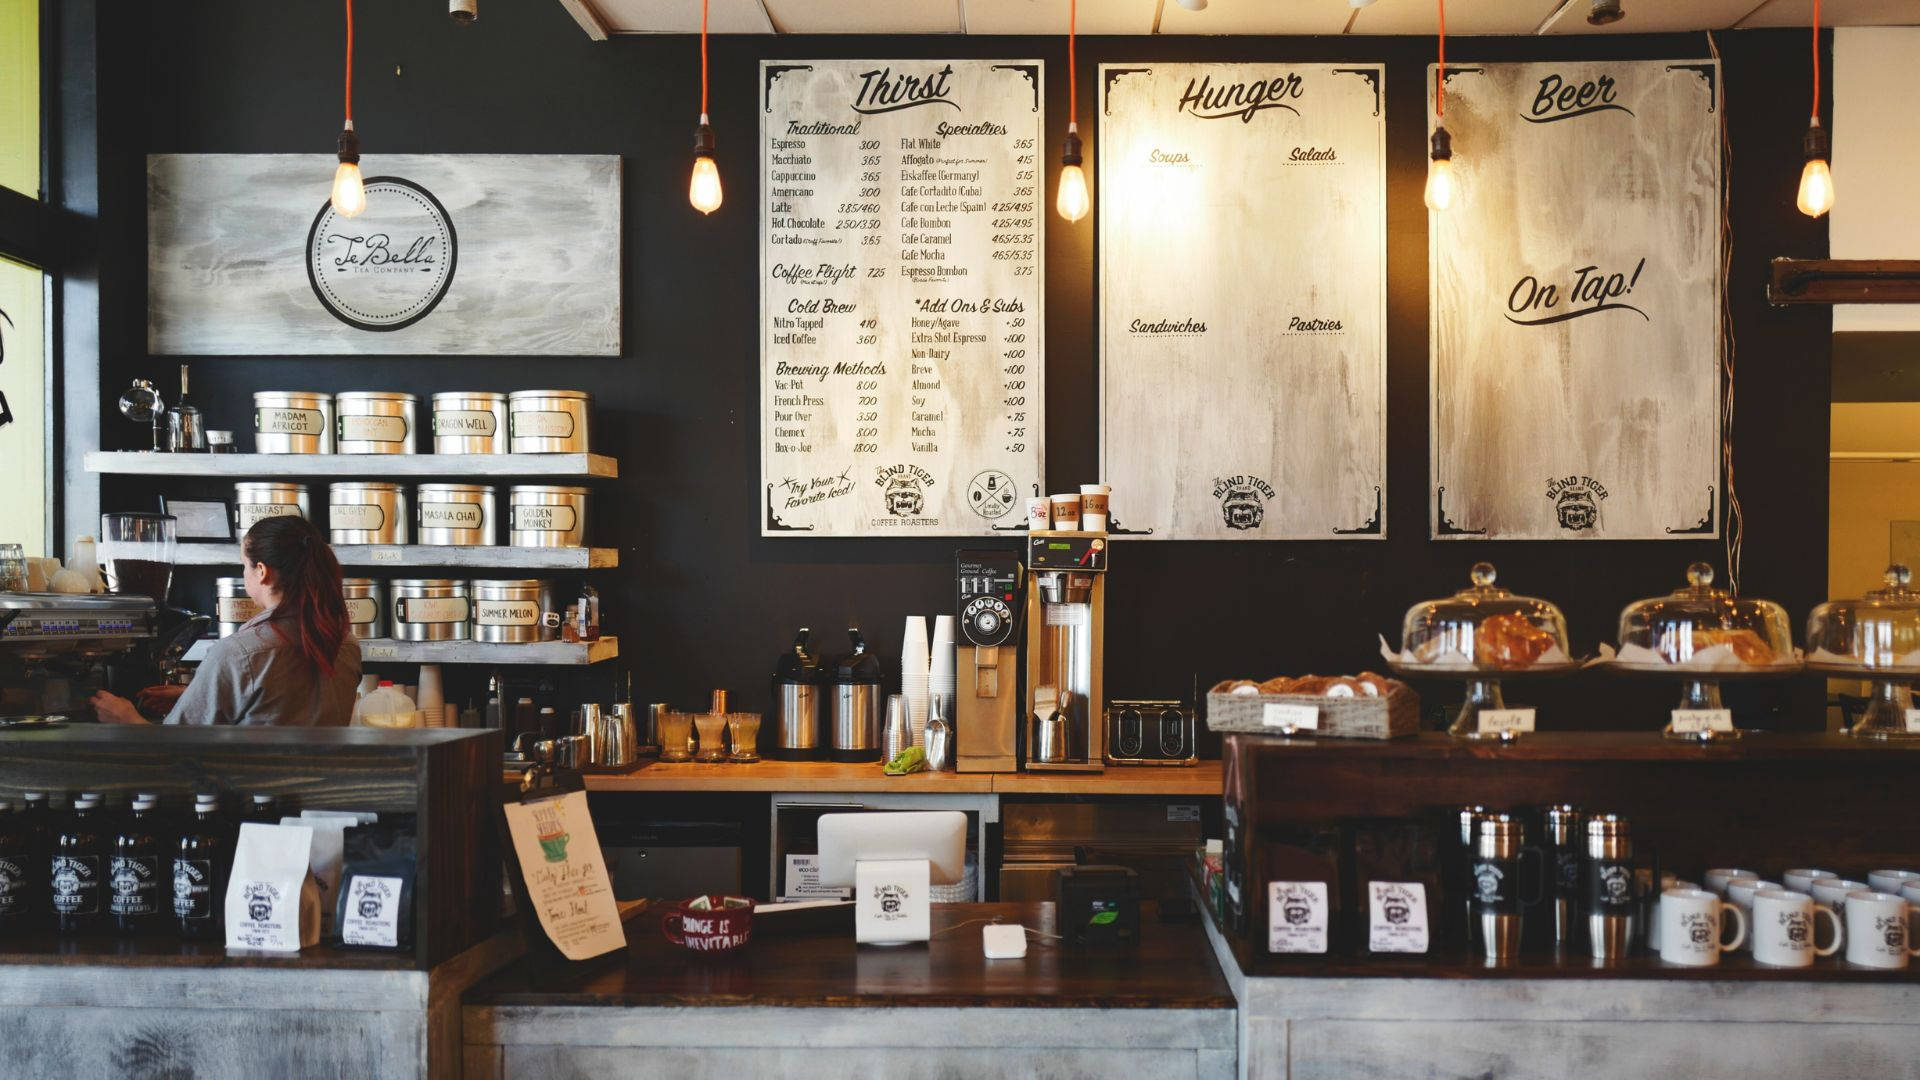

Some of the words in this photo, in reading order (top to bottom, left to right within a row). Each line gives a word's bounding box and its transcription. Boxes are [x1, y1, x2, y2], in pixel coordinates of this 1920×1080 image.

[856, 64, 953, 107] Thirst
[1178, 72, 1303, 123] Hunger
[1531, 74, 1617, 117] Beer
[787, 121, 861, 135] Traditional
[936, 121, 1008, 139] Specialties
[772, 138, 806, 151] Espresso
[901, 138, 916, 149] Flat
[919, 138, 941, 149] White
[772, 154, 812, 165] Macchiato
[901, 154, 934, 166] Affogato
[1149, 149, 1190, 165] Soups
[1289, 148, 1337, 162] Salads
[772, 170, 816, 183] Cappuccino
[901, 170, 936, 181] Eiskaffee
[938, 170, 979, 182] (Germany)
[772, 188, 814, 197] Americano
[901, 186, 917, 196] Cafe
[920, 186, 957, 196] Cortadito
[772, 202, 792, 213] Latte
[901, 202, 917, 212] Cafe
[920, 204, 934, 212] con
[936, 202, 958, 212] Leche
[960, 202, 986, 214] (Spain)
[772, 218, 784, 229] Hot
[788, 218, 825, 229] Chocolate
[901, 217, 918, 228] Cafe
[920, 217, 951, 228] Bombon
[772, 234, 803, 245] Cortado
[902, 233, 918, 244] Cafe
[920, 233, 952, 244] Caramel
[902, 250, 918, 260] Cafe
[920, 250, 945, 260] Mocha
[772, 264, 813, 284] Coffee
[816, 264, 857, 285] Flight
[902, 265, 936, 278] Espresso
[937, 265, 968, 276] Bombon
[1508, 276, 1559, 313] On
[1570, 258, 1645, 307] Tap!
[788, 299, 820, 313] Cold
[822, 299, 857, 313] Brew
[951, 298, 977, 313] Ons
[980, 298, 990, 314] &
[992, 298, 1025, 313] Subs
[774, 317, 795, 328] Nitro
[796, 317, 824, 331] Tapped
[912, 318, 960, 329] Honey/Agave
[1129, 318, 1207, 334] Sandwiches
[1288, 317, 1343, 332] Pastries
[774, 333, 790, 344] Iced
[792, 334, 816, 344] Coffee
[912, 332, 933, 343] Extra
[934, 332, 951, 343] Shot
[953, 332, 987, 345] Espresso
[912, 348, 950, 360] Non-Dairy
[776, 361, 830, 382] Brewing
[833, 361, 887, 375] Methods
[912, 364, 933, 374] Breve
[912, 380, 941, 390] Almond
[774, 395, 801, 406] French
[803, 395, 824, 406] Press
[912, 395, 926, 408] Soy
[274, 412, 307, 421] MADAM
[775, 410, 793, 421] Pour
[795, 410, 812, 421] Over
[912, 411, 944, 421] Caramel
[272, 422, 308, 431] APRICOT
[438, 418, 464, 430] DRAGON
[466, 418, 488, 430] WELL
[775, 427, 805, 438] Chemex
[912, 427, 936, 437] Mocha
[912, 442, 938, 453] Vanilla
[875, 464, 904, 487] BLIND
[908, 464, 935, 487] TIGER
[790, 479, 807, 494] Try
[810, 475, 836, 489] Your
[1213, 476, 1244, 499] BLIND
[1248, 476, 1275, 500] TIGER
[1546, 476, 1577, 500] BLIND
[1582, 476, 1608, 500] TIGER
[785, 488, 826, 510] Favorite
[827, 482, 856, 500] Iced!
[1085, 499, 1094, 509] 16
[244, 506, 284, 515] BREAKFAST
[425, 511, 454, 520] MASALA
[456, 512, 476, 521] CHAI
[523, 509, 552, 518] GOLDEN
[1031, 507, 1037, 518] 8
[1056, 506, 1066, 516] 12
[523, 519, 552, 529] MONKEY
[901, 518, 939, 526] ROASTERS
[482, 609, 507, 618] SUMMER
[510, 609, 533, 618] MELON
[54, 894, 83, 903] COFFEE
[112, 895, 143, 904] COFFEE
[720, 920, 730, 934] IS
